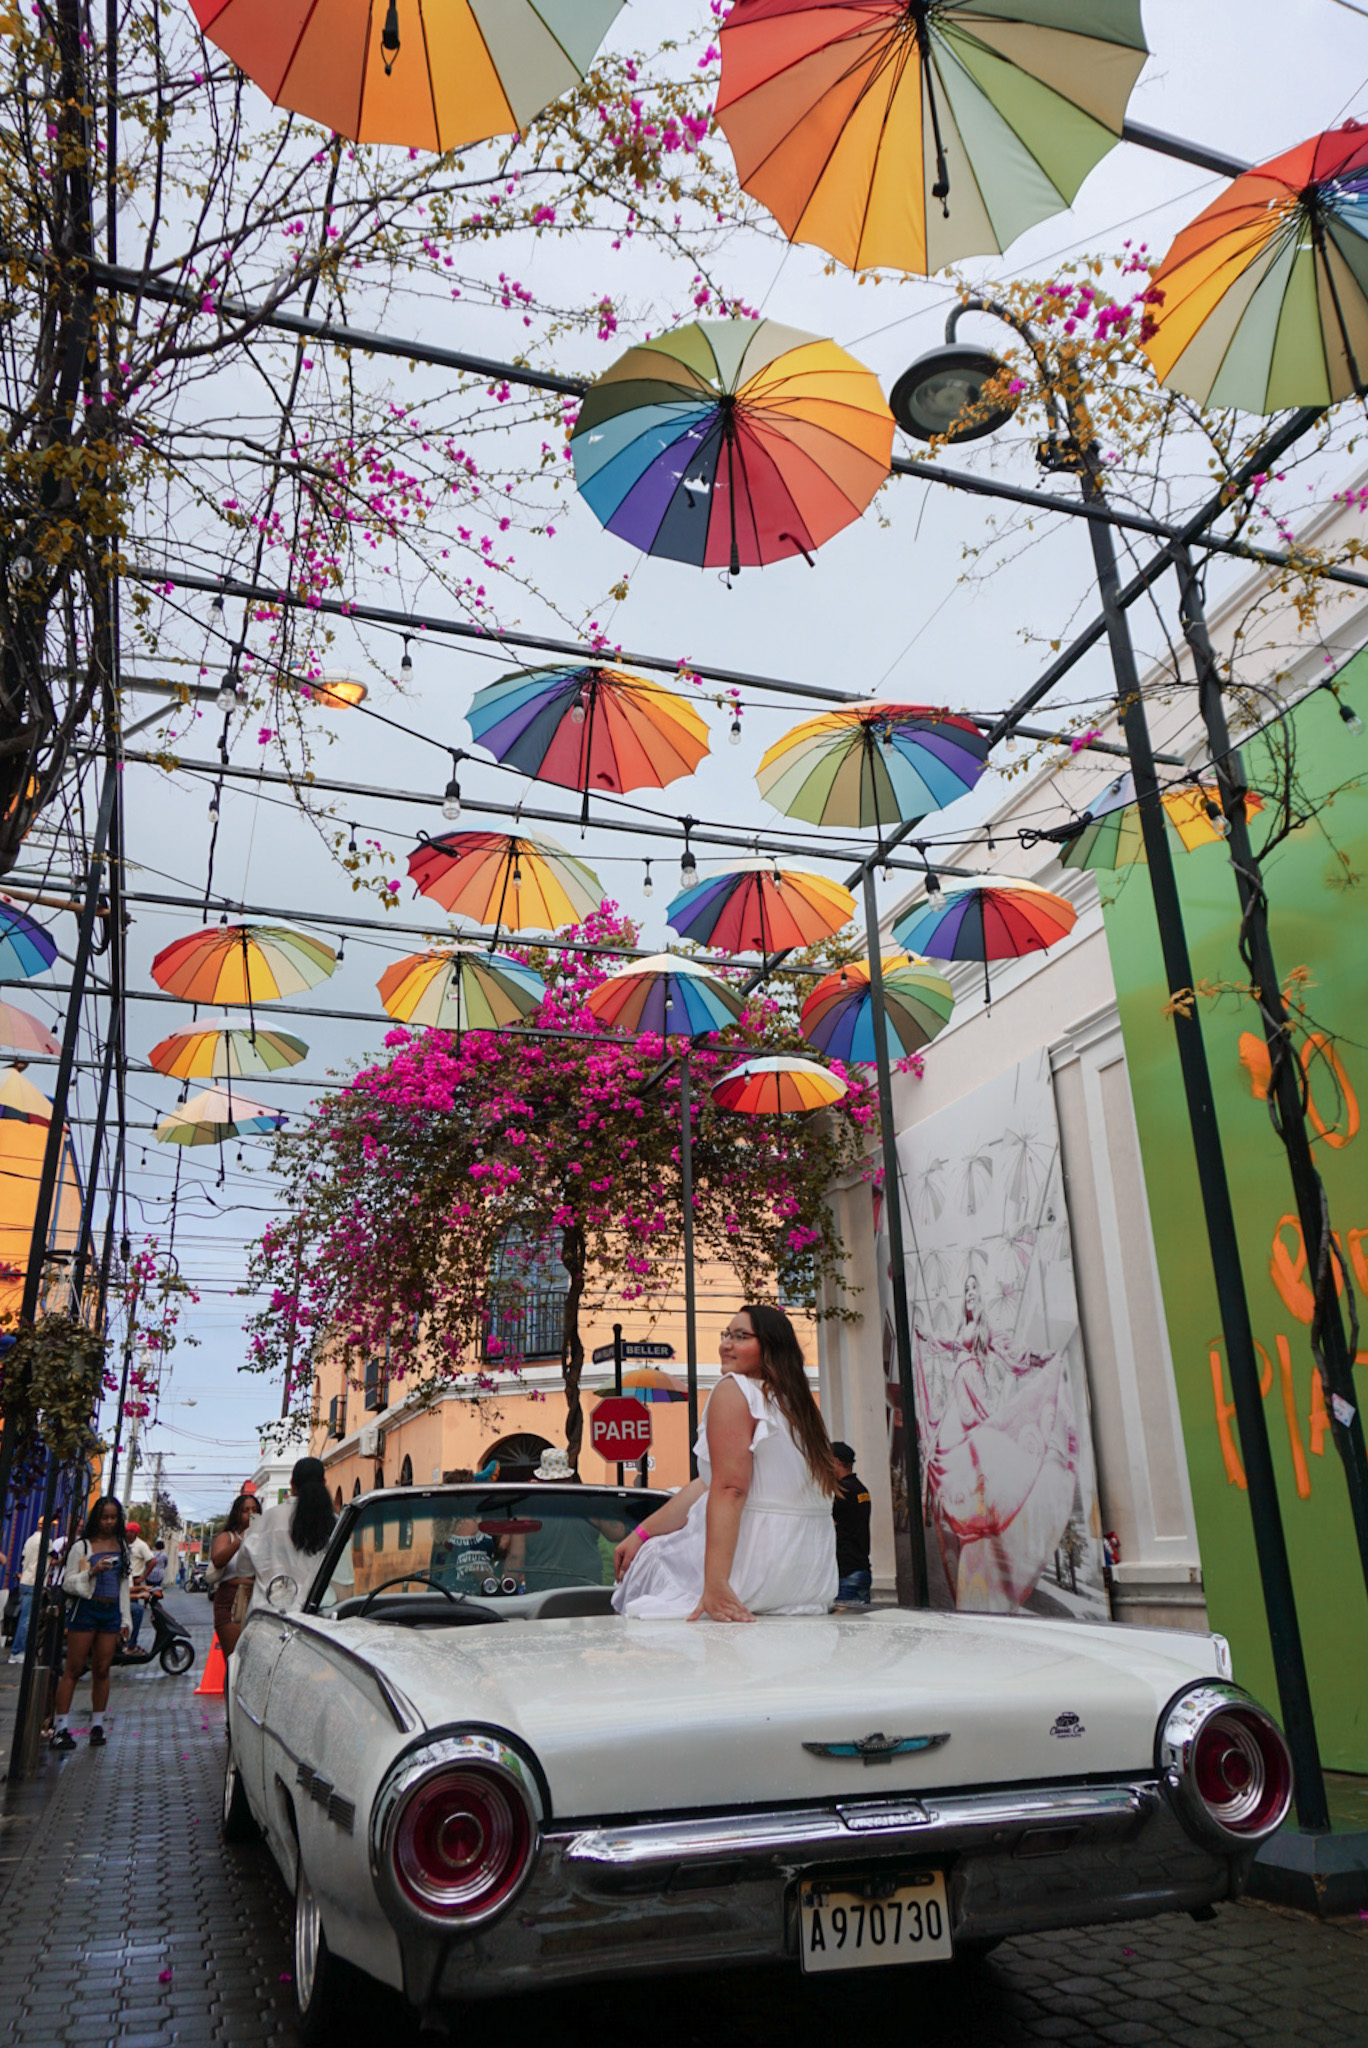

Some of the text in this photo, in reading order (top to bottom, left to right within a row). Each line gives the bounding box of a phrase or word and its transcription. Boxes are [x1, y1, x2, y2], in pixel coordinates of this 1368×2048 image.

[626, 1345, 669, 1355] BELLER
[593, 1419, 650, 1441] PARE
[811, 1899, 942, 1952] A970730
